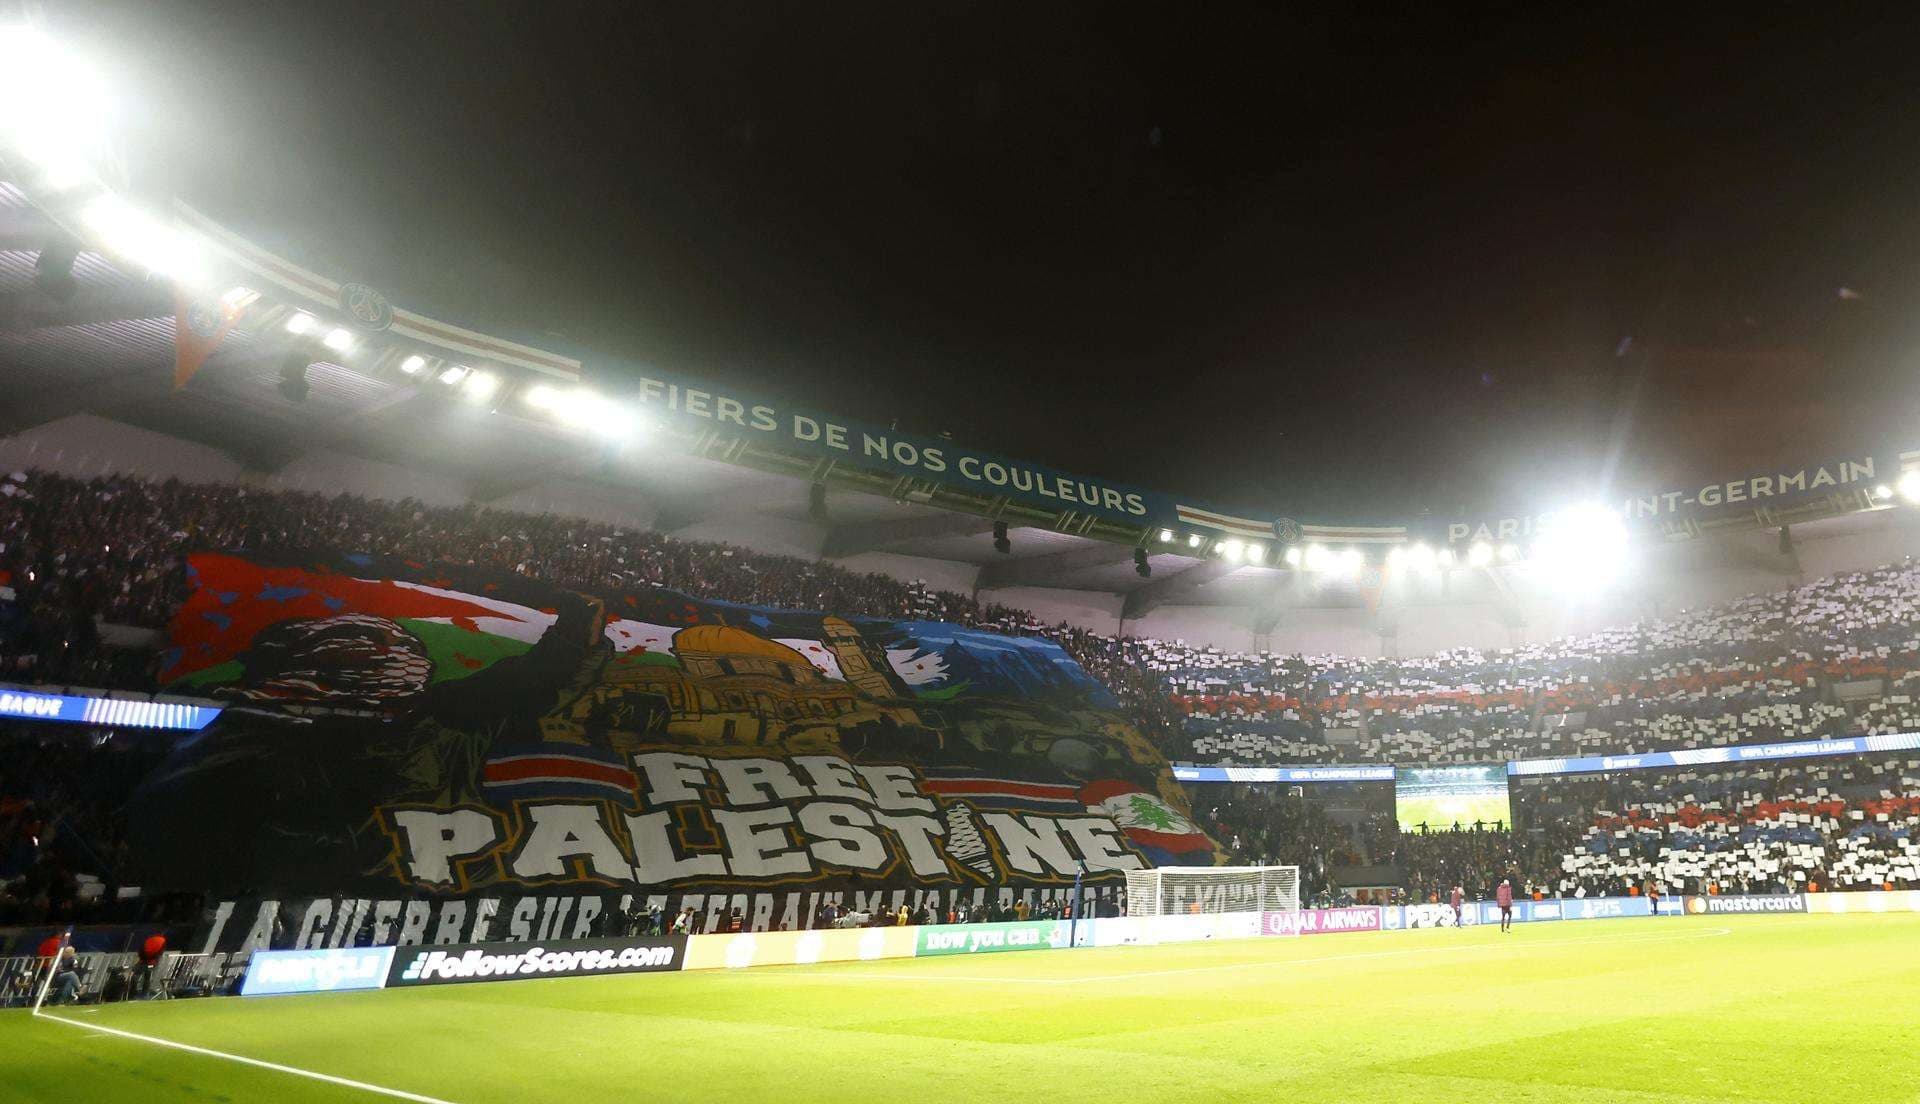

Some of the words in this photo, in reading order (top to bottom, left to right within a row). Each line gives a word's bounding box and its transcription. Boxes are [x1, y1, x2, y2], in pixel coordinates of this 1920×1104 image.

[639, 377, 777, 432] FIERS
[794, 414, 849, 450] DE
[863, 432, 946, 473] NOS
[958, 457, 1147, 516] COULEURS
[0, 692, 63, 716] EAGUE
[633, 752, 937, 813] FREE
[1404, 903, 1459, 929] PEPS
[1709, 895, 1803, 912] mastercard
[296, 897, 500, 951] GUERRE
[506, 895, 602, 943] SUR
[1322, 909, 1377, 930] AIRWAYS
[926, 930, 969, 949] now
[970, 929, 1005, 952] you
[1007, 927, 1040, 945] can
[420, 946, 675, 980] FollowScores.com
